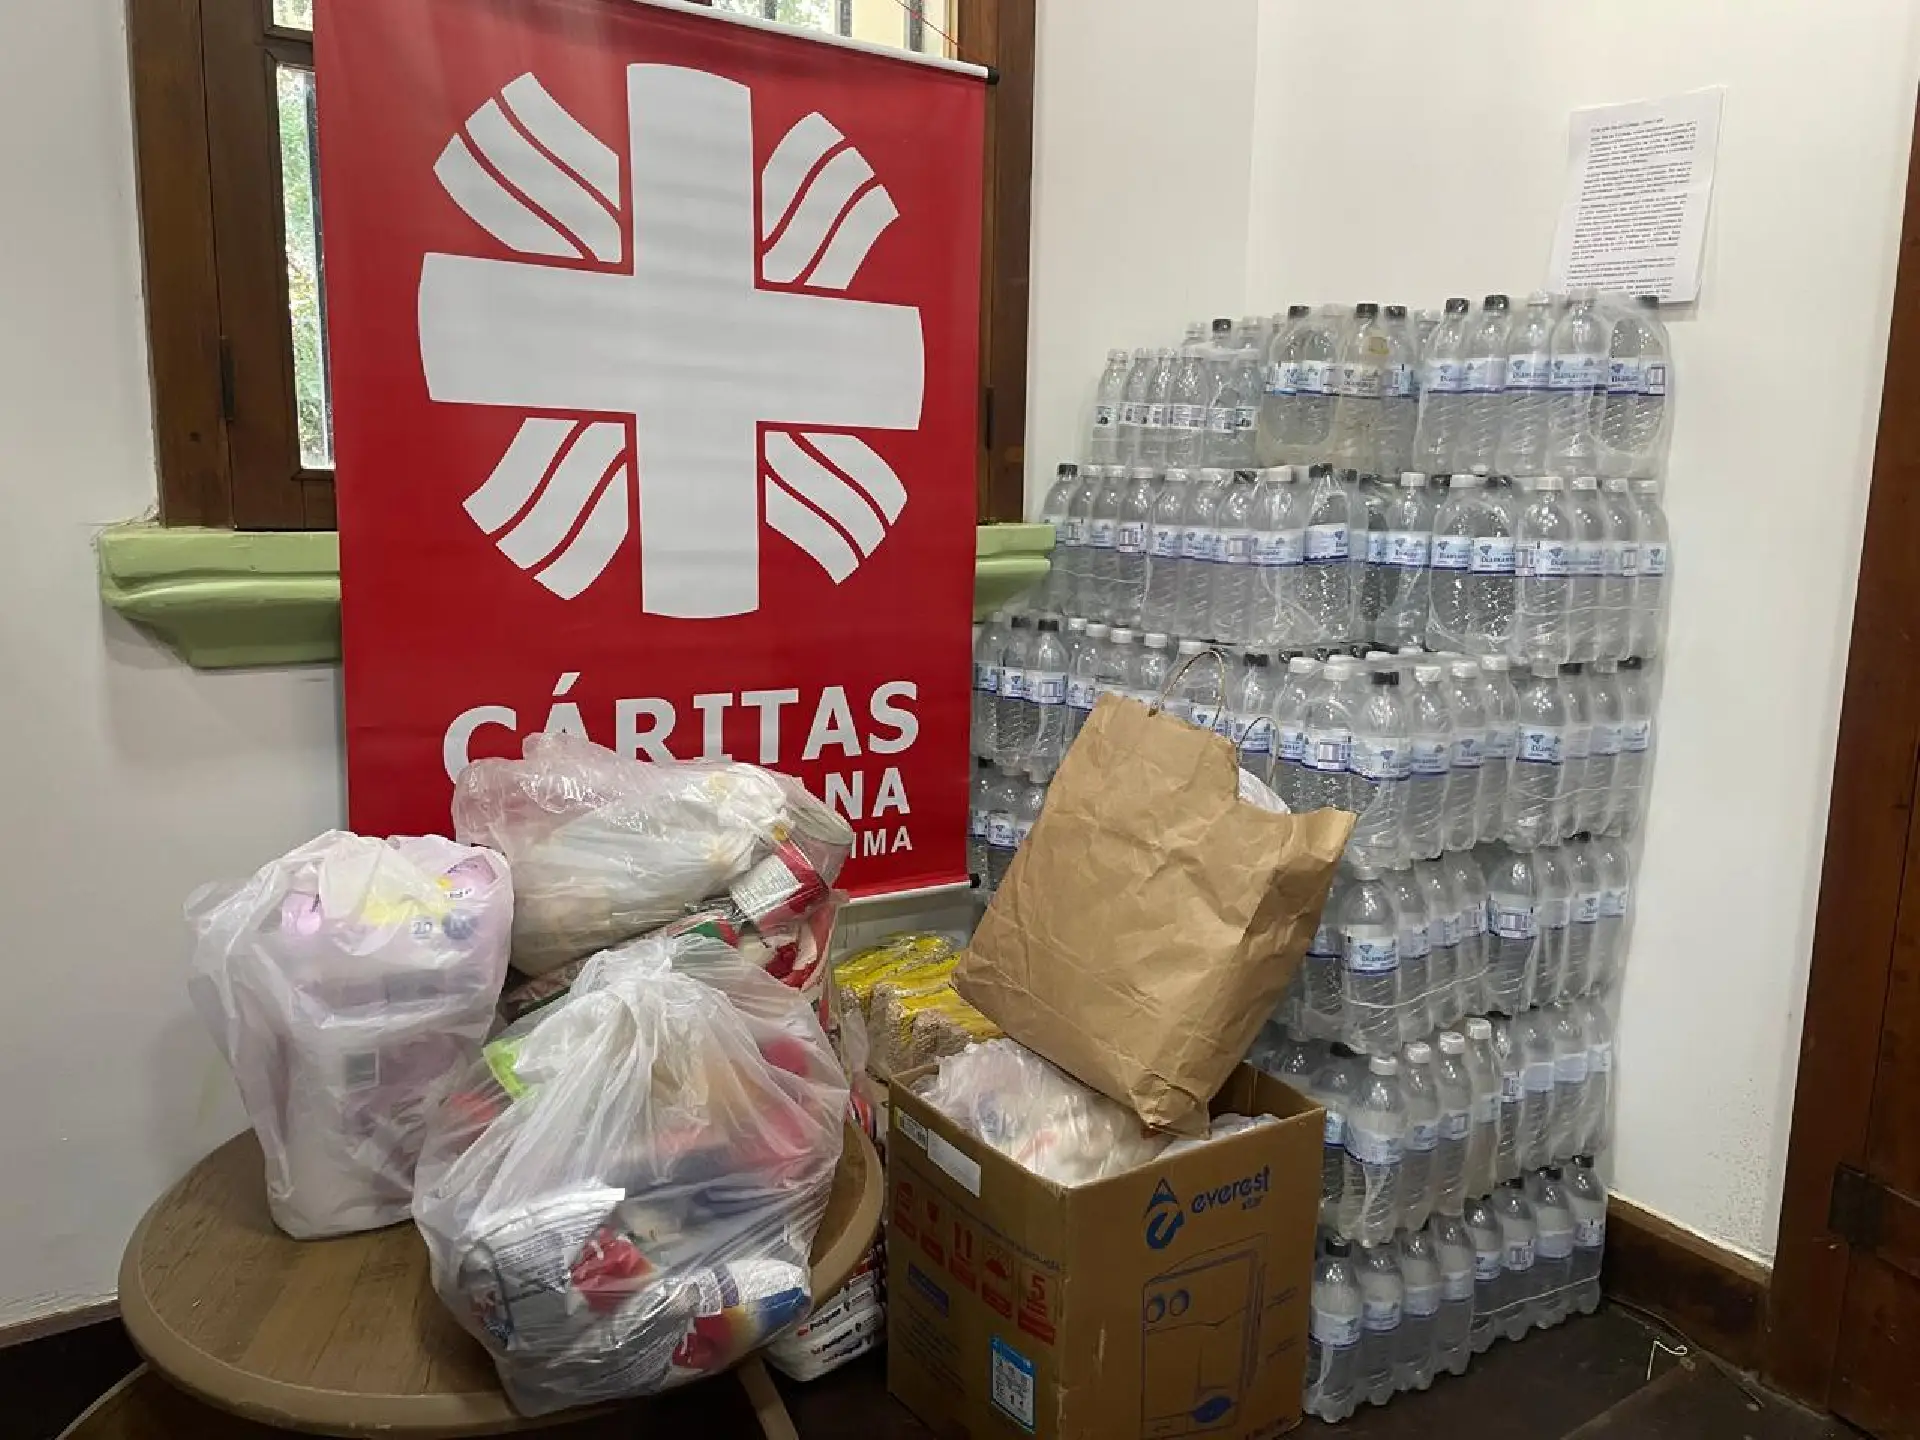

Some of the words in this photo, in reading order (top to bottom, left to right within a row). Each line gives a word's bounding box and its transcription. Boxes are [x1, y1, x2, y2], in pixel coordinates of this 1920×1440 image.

[442, 672, 920, 784] CÁRITAS
[849, 825, 913, 859] IMA
[1189, 1164, 1272, 1214] everest
